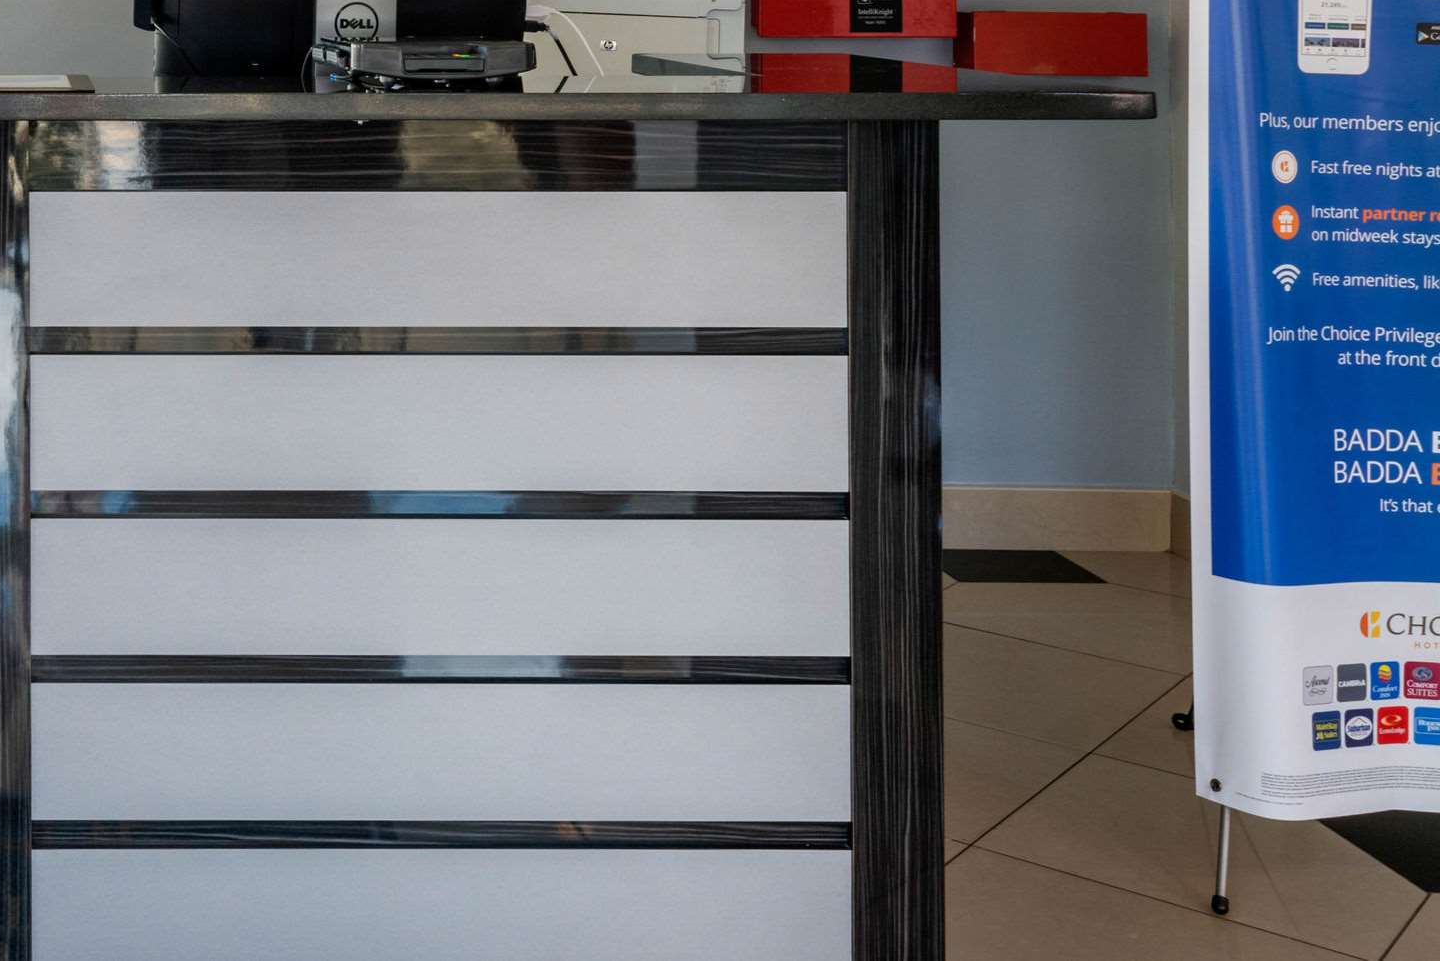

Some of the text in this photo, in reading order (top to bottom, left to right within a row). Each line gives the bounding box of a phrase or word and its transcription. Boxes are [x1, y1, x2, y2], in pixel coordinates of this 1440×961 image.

[340, 18, 374, 30] DELL
[1259, 112, 1291, 130] Plus,
[1293, 116, 1319, 129] our
[1322, 115, 1404, 132] members
[1311, 160, 1339, 174] Fast
[1342, 160, 1372, 175] free
[1376, 161, 1423, 180] nights
[1311, 205, 1360, 219] Instant
[1362, 208, 1426, 224] partner
[1311, 228, 1440, 249] on midweek stays
[1312, 272, 1340, 286] Free
[1342, 274, 1419, 290] amenities,
[1266, 326, 1295, 345] Join
[1297, 325, 1318, 341] the
[1321, 325, 1370, 342] Choice
[1337, 352, 1352, 366] at
[1355, 349, 1381, 366] the
[1385, 350, 1427, 368] front
[1333, 428, 1424, 453] BADDA
[1333, 460, 1423, 485] BADDA
[1379, 498, 1399, 512] It's
[1402, 498, 1433, 513] that
